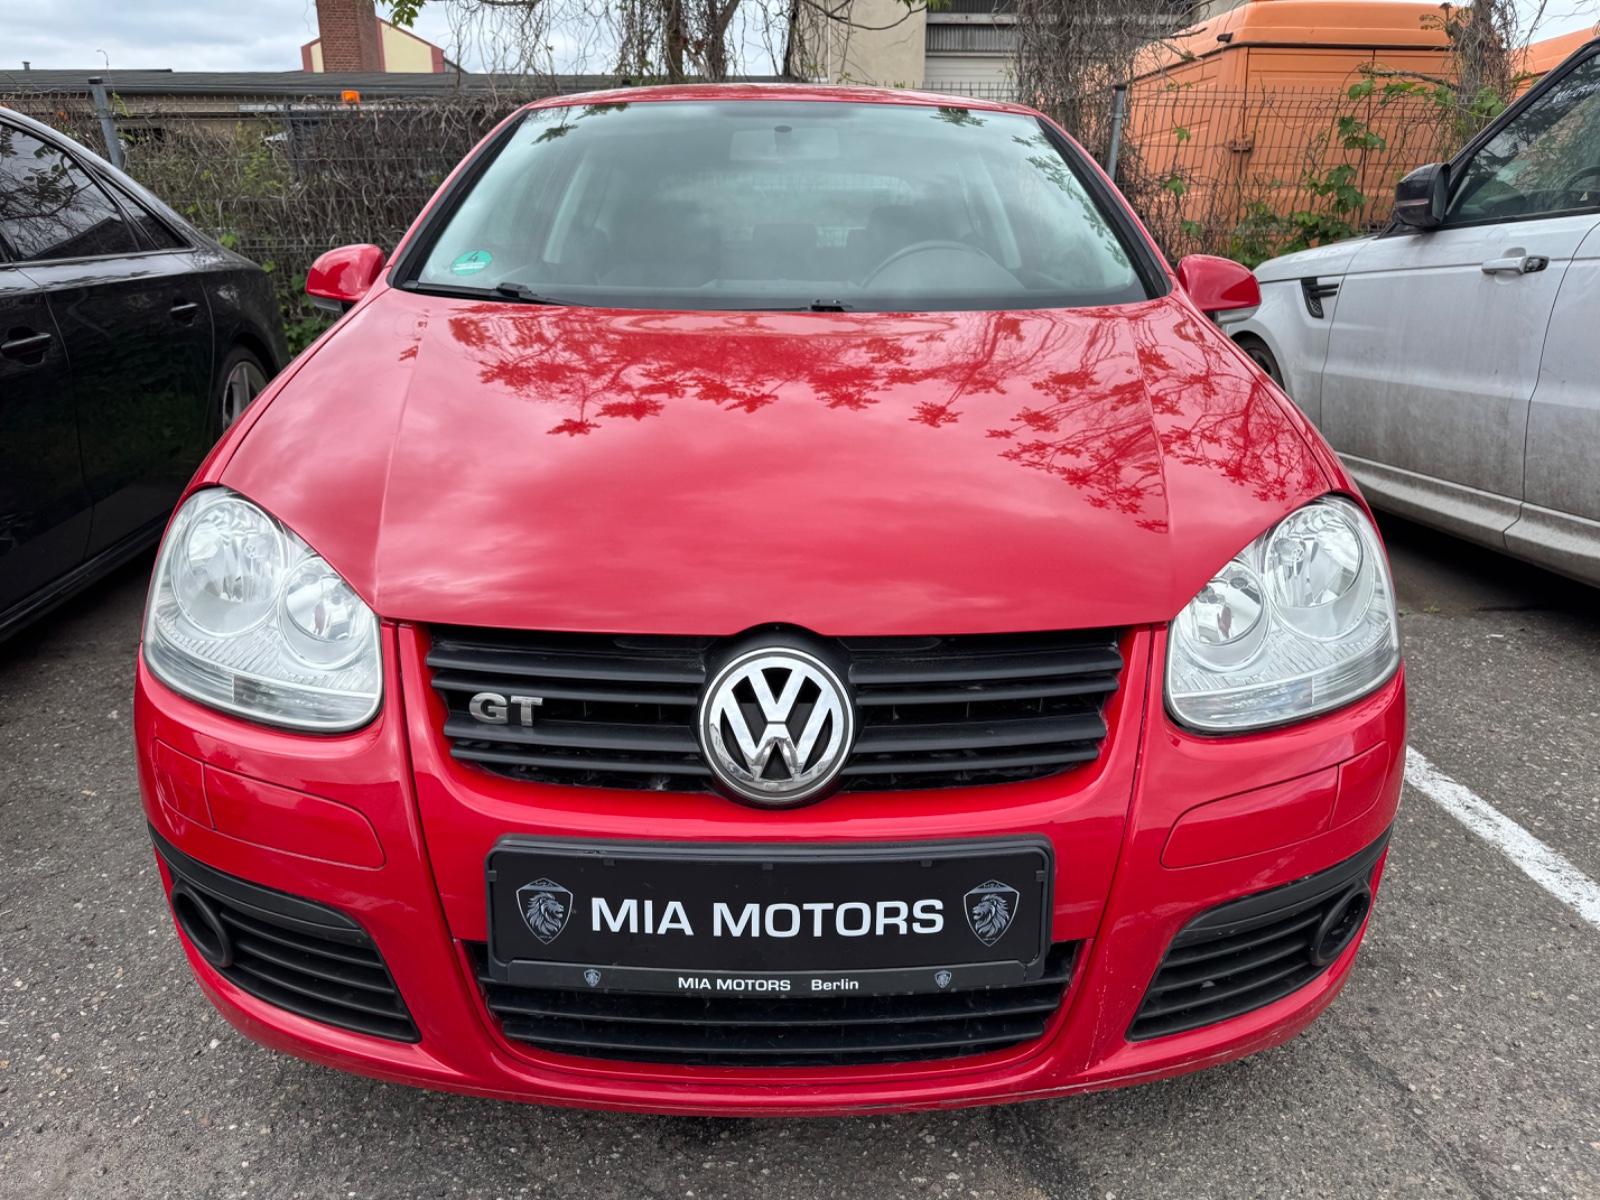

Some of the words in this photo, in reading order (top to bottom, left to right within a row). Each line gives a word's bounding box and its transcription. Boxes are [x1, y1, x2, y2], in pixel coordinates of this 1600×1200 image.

[469, 692, 543, 727] GT
[708, 656, 845, 793] VW
[591, 897, 694, 936] MIA
[713, 898, 944, 938] MOTORS
[678, 976, 712, 990] MIA
[716, 978, 791, 992] MOTORS
[811, 978, 859, 991] Berlin
